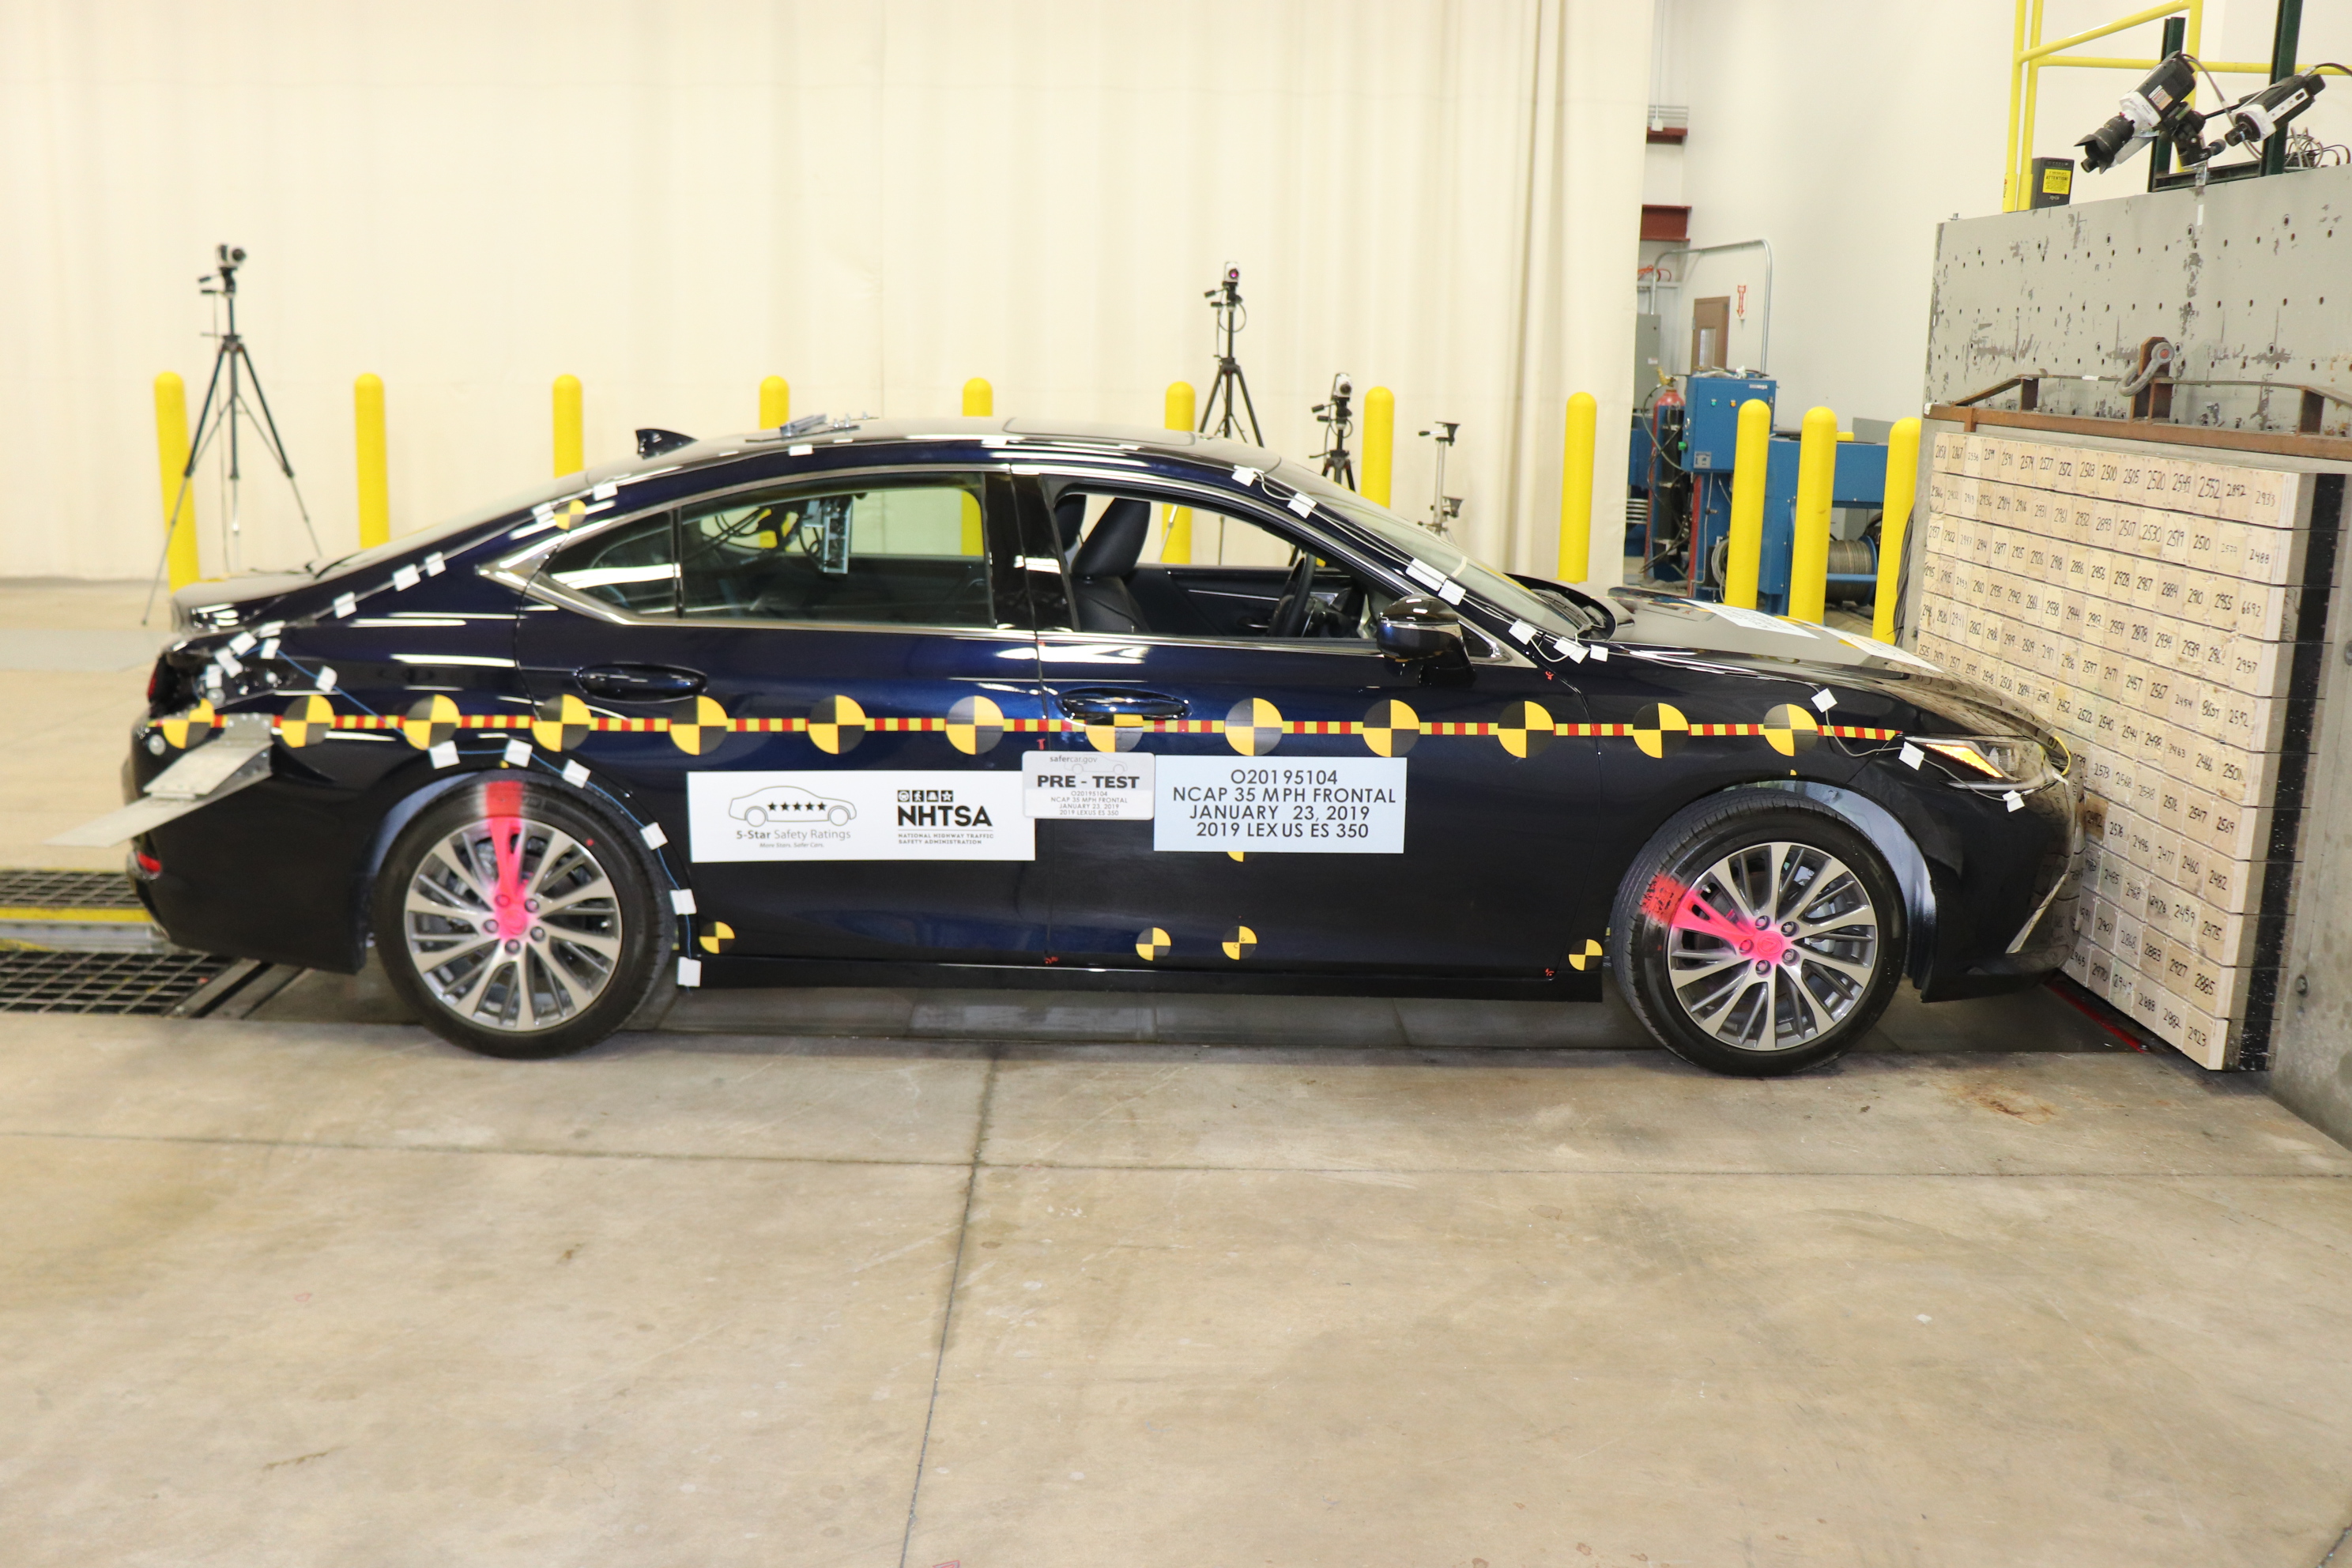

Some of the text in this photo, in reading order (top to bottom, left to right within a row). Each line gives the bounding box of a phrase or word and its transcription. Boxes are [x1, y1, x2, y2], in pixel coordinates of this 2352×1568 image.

[1038, 775, 1076, 787] PRE
[1092, 776, 1140, 788] TEST
[1174, 786, 1396, 803] NCAP 35 MPH FRONTAL
[898, 805, 993, 827] NHTSA
[1189, 805, 1370, 822] JANUARY 23, 2019
[737, 829, 850, 841] 5-Star Safety Ratings
[1197, 822, 1369, 838] 2019 LEXUS ES 350
